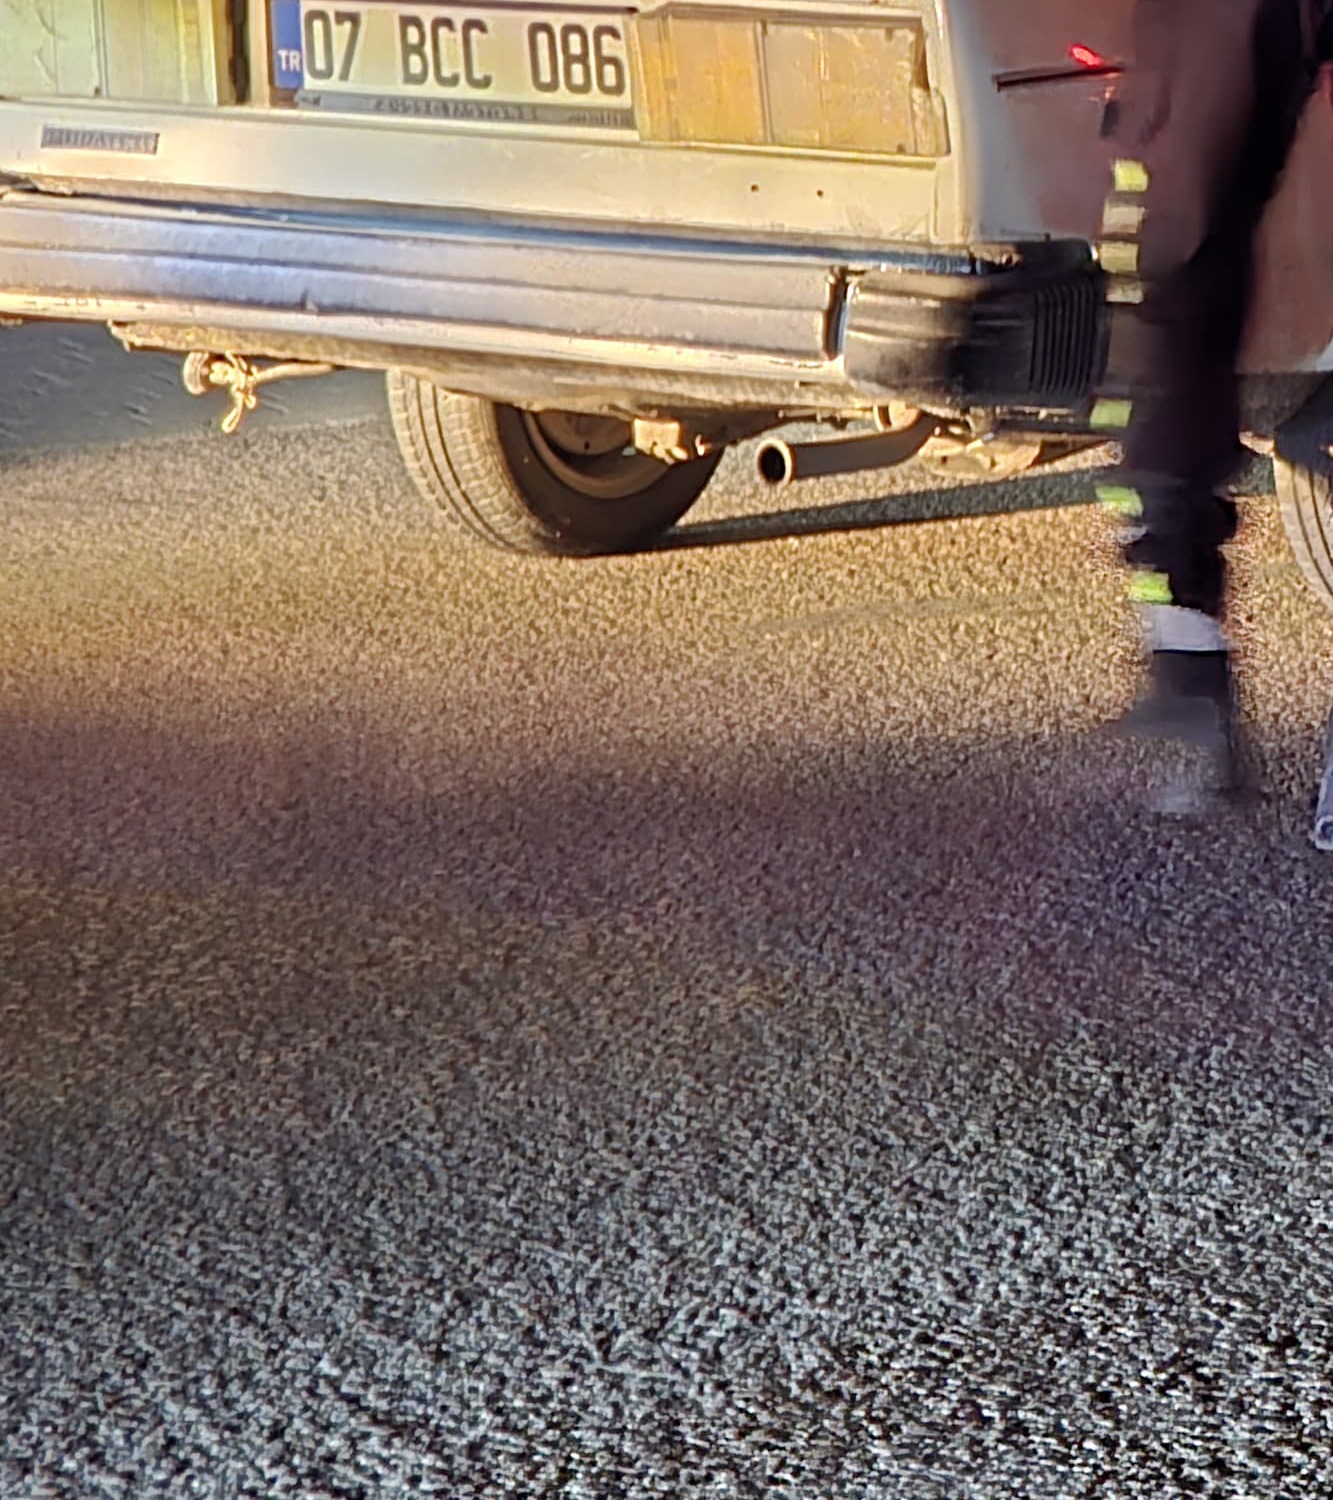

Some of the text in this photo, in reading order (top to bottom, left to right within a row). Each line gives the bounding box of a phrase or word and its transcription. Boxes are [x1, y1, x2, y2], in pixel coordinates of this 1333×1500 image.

[278, 49, 303, 74] TR
[304, 8, 627, 98] 07 BCC 086
